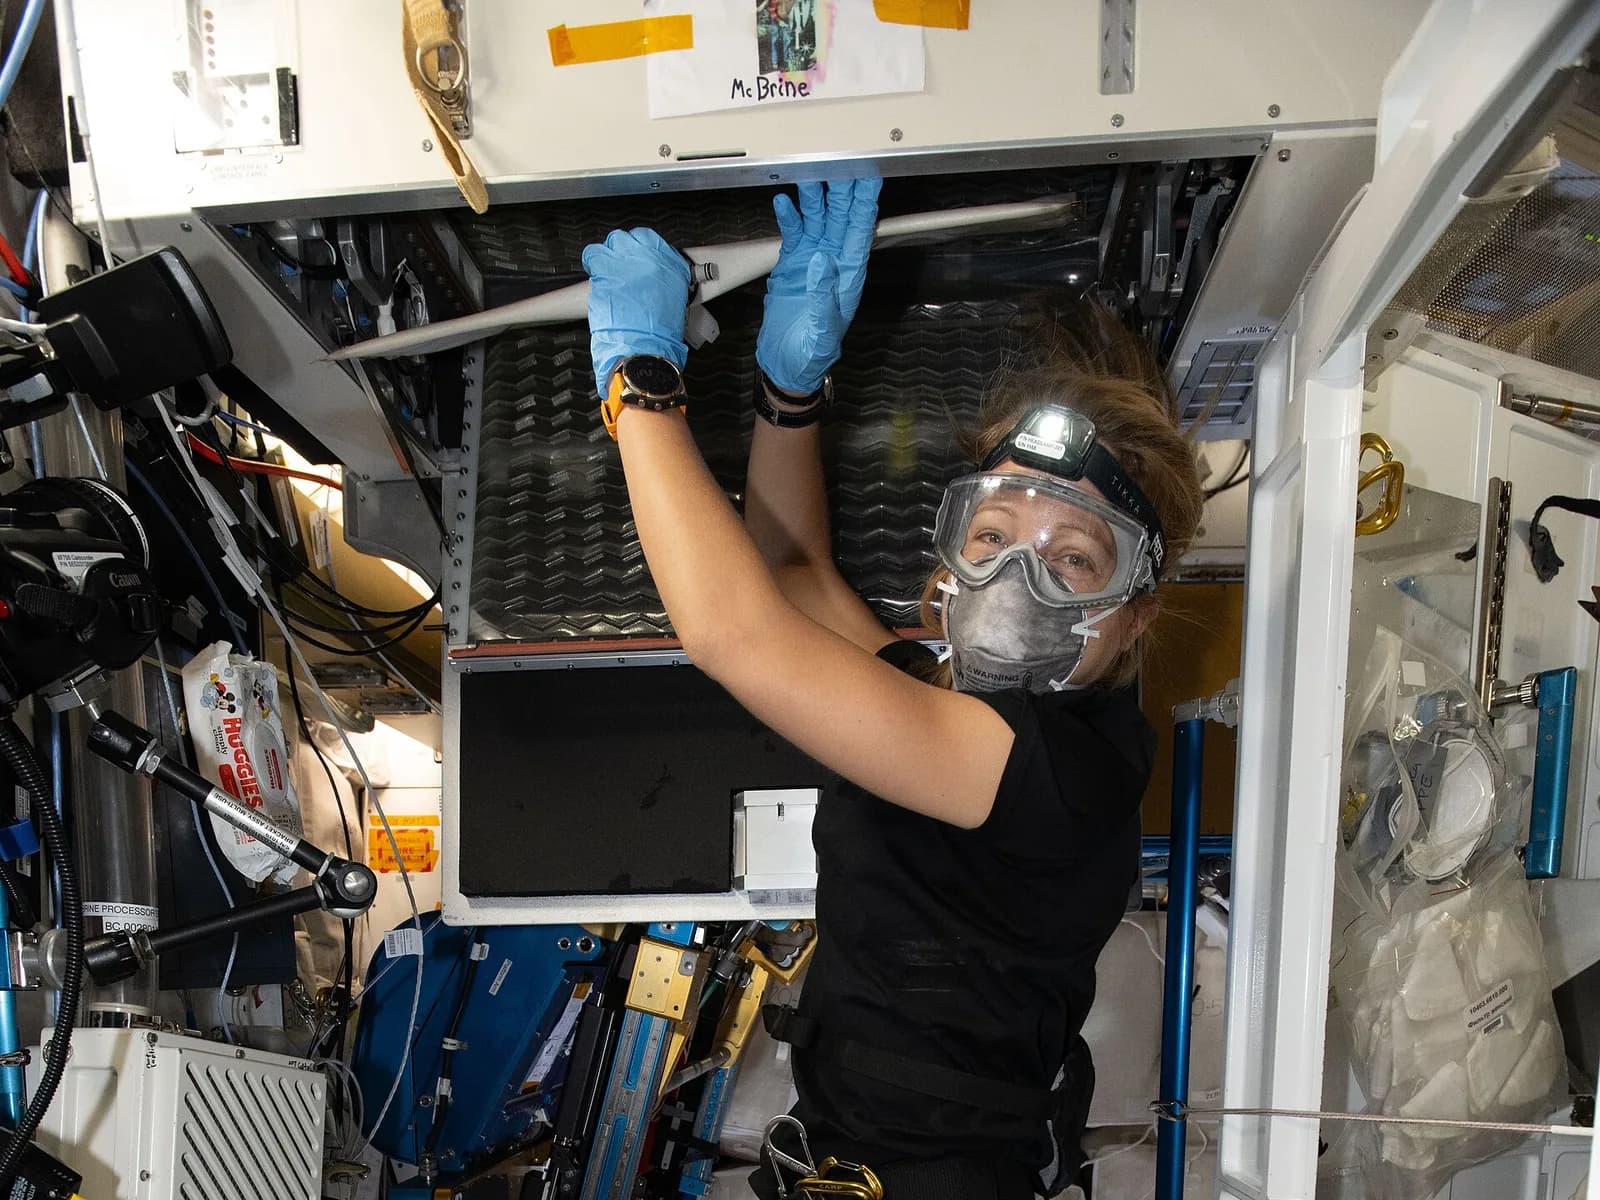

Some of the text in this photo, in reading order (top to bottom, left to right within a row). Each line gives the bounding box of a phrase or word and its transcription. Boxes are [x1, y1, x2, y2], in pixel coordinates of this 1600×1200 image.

[109, 572, 141, 588] Canon
[973, 668, 1019, 682] WARNING
[216, 725, 228, 755] simply
[223, 716, 263, 808] HUGGIES
[264, 748, 276, 790] HUGGIES
[213, 792, 246, 816] MULTI-USE
[263, 823, 293, 845] BRACKET
[102, 905, 154, 916] PROCESSOR
[105, 922, 120, 930] BC
